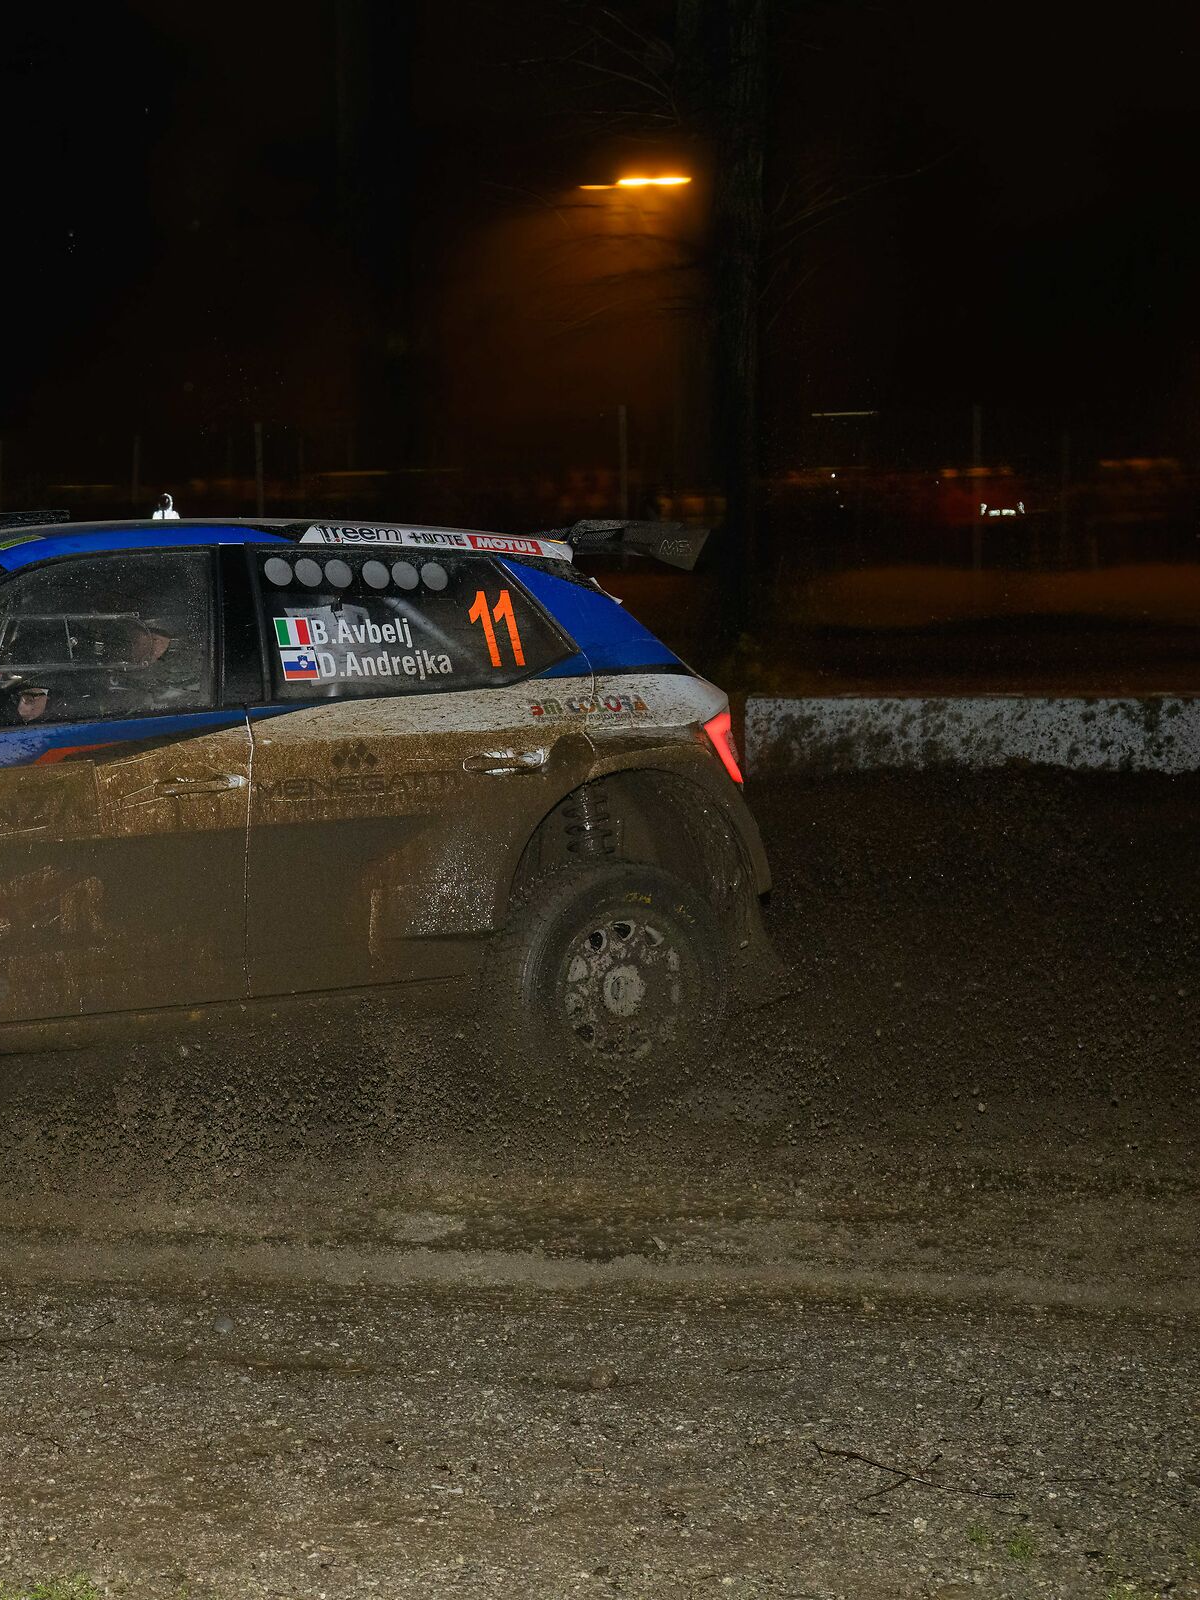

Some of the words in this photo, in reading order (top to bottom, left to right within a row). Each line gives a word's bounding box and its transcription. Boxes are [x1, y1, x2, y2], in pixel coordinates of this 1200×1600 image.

[476, 537, 537, 553] MOTUL
[310, 616, 413, 648] B.Avbelj
[468, 589, 526, 667] 11
[317, 650, 453, 681] D.Andrejka
